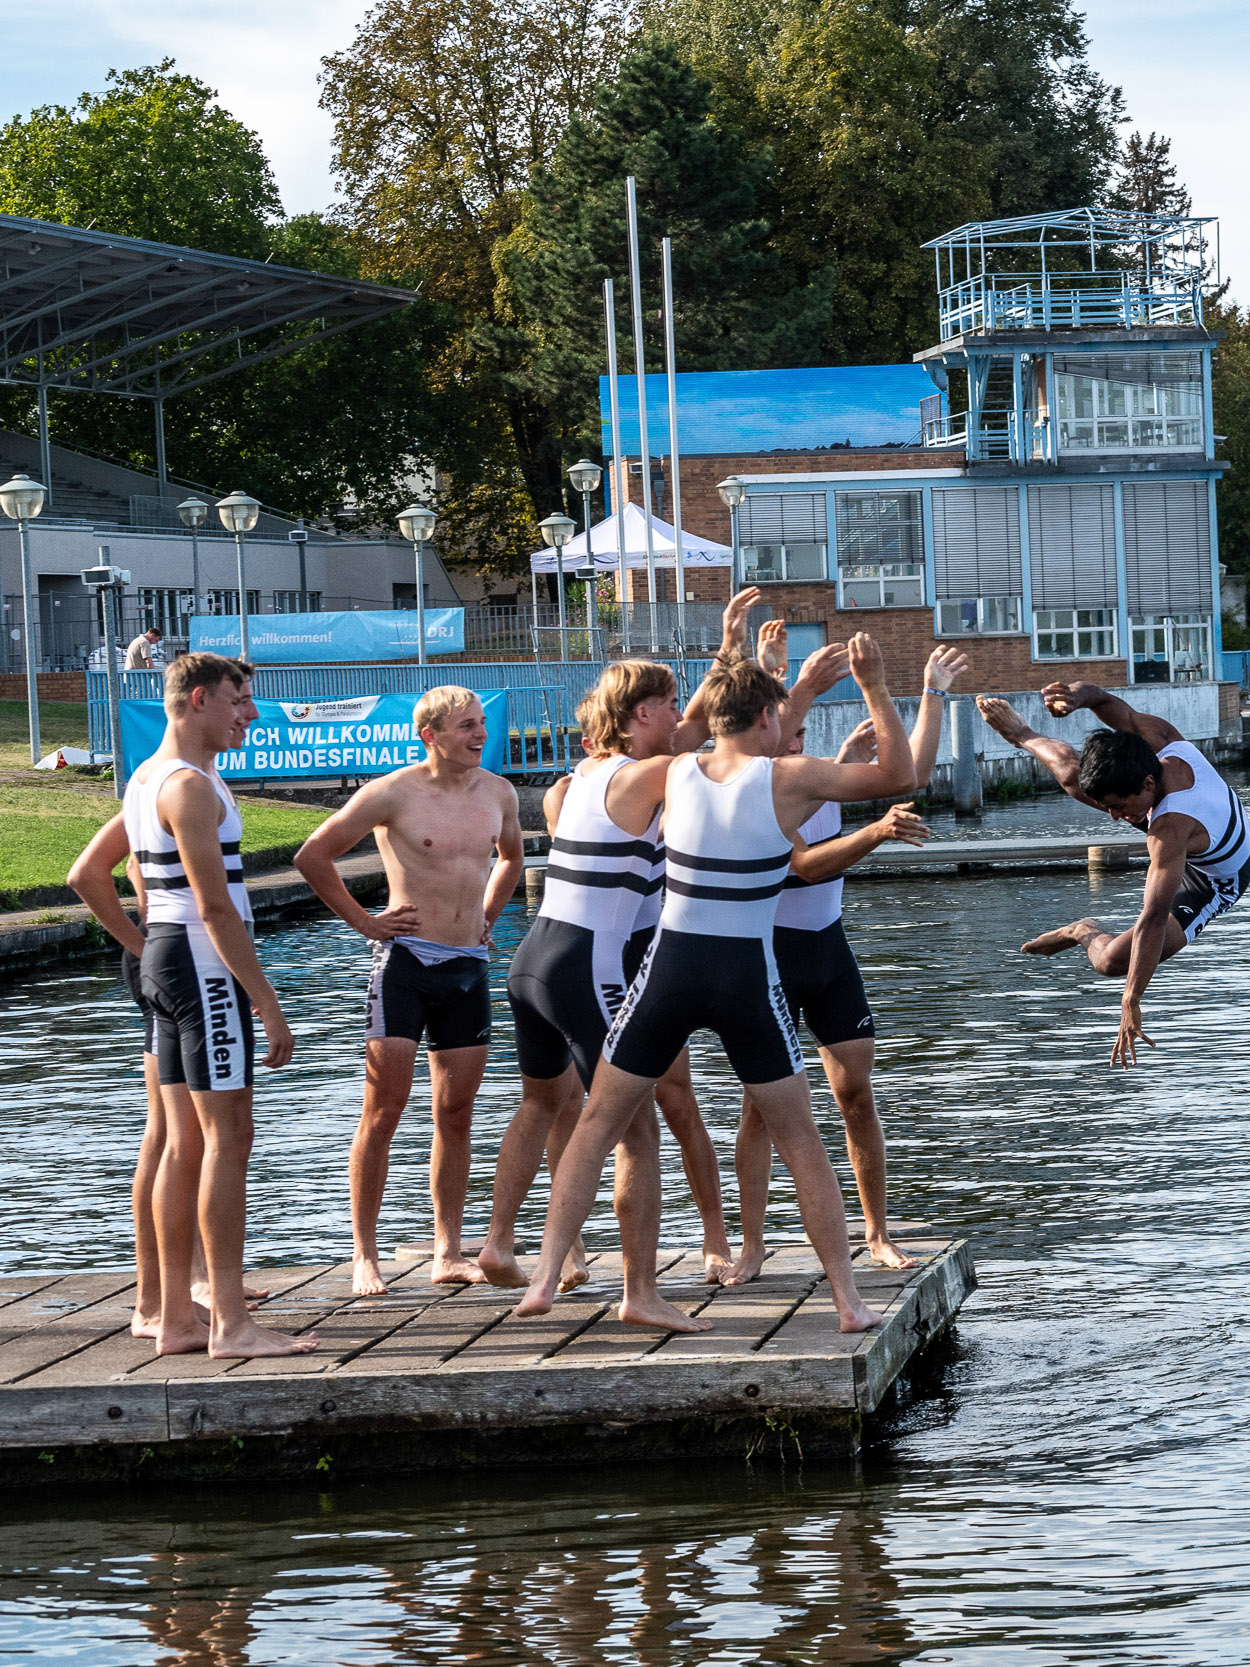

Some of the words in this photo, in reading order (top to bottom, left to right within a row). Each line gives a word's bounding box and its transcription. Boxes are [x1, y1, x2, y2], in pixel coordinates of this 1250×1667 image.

[199, 634, 241, 647] Herzlic
[251, 631, 332, 645] willkommen!
[427, 626, 454, 638] DRJ
[315, 703, 336, 712] Jugend
[242, 727, 280, 746] ICH
[287, 723, 421, 745] WILLKOMME
[214, 751, 247, 770] UM
[254, 745, 420, 770] BUNDESFINALE
[204, 977, 237, 1080] Minden
